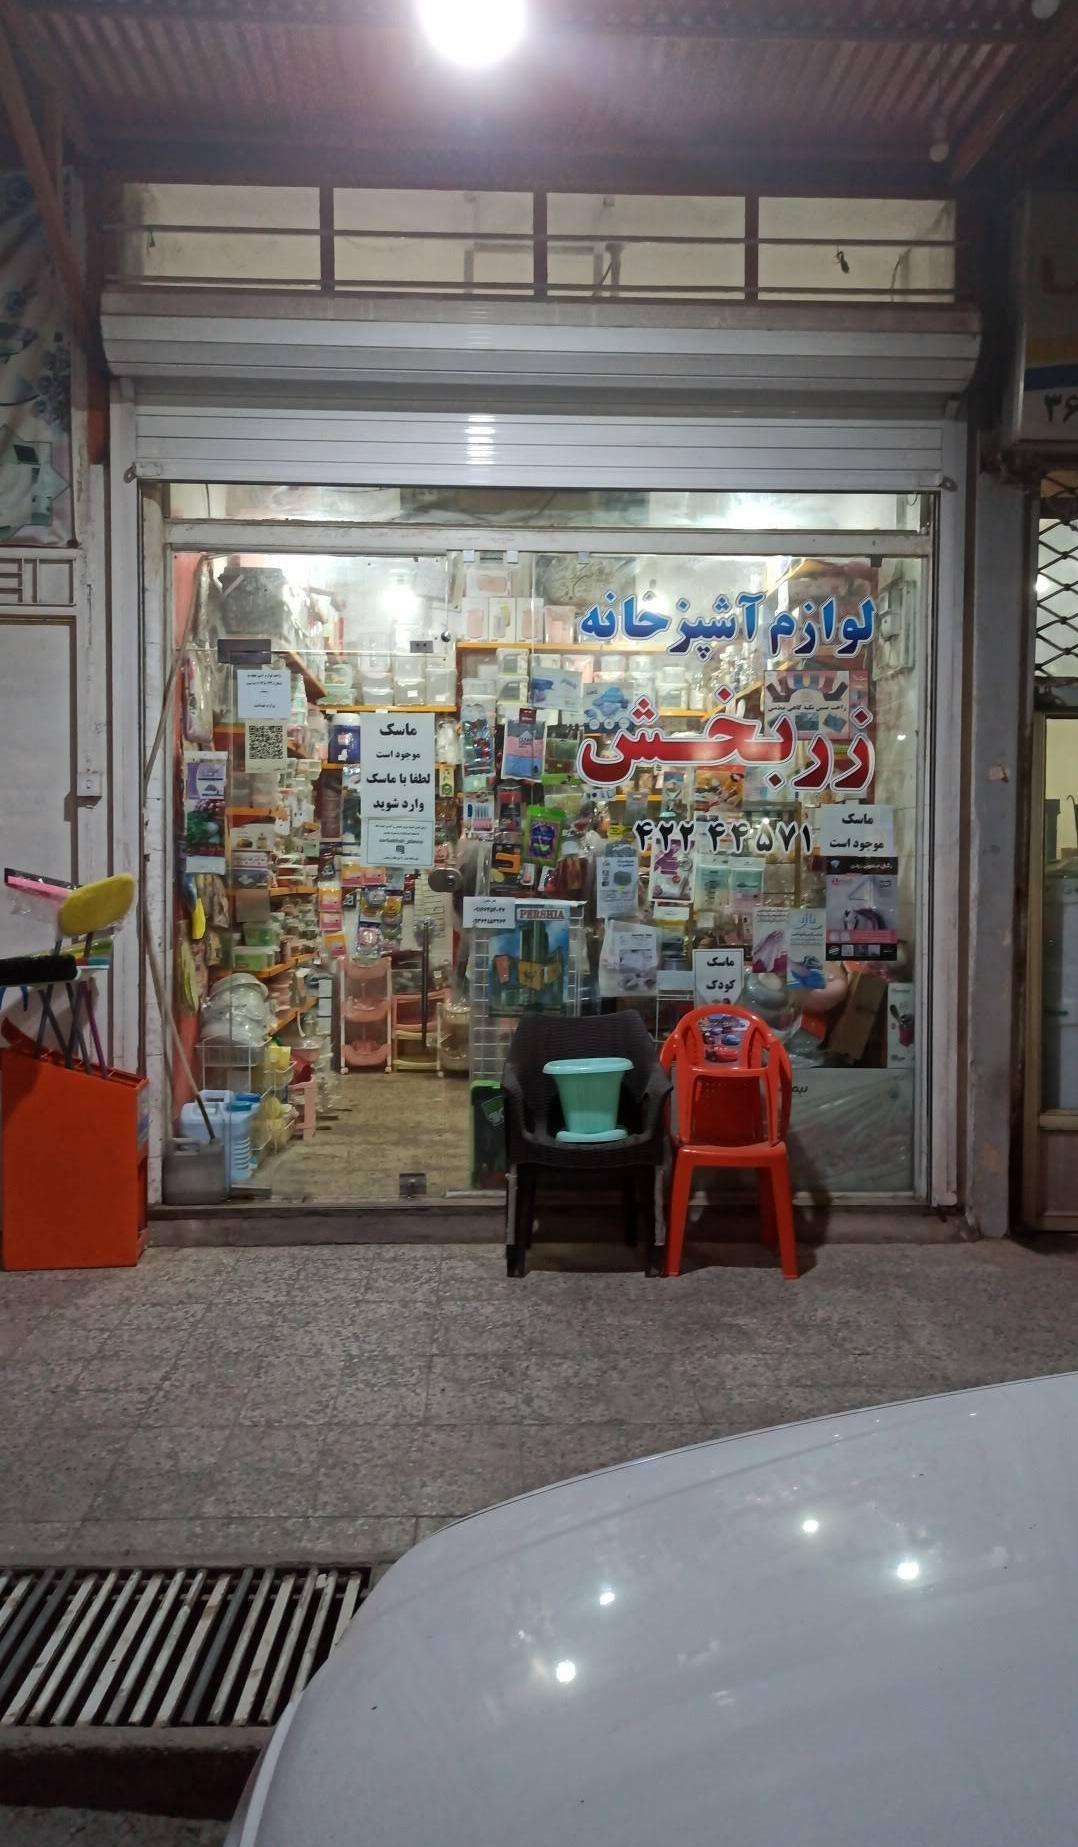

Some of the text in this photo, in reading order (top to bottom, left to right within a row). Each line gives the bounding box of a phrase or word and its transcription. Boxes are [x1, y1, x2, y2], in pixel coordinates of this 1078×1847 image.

[580, 591, 877, 662] لوازم آشپزخانه
[379, 722, 417, 736] ماسک
[576, 686, 876, 792] زربخش
[376, 750, 421, 761] موجود است
[366, 773, 430, 787] لطفا با ماسک
[373, 798, 425, 812] وارد شوید
[842, 813, 874, 825] ماسک
[829, 838, 884, 852] موجود است
[706, 956, 735, 967] ماسک
[706, 979, 736, 993] کودک
